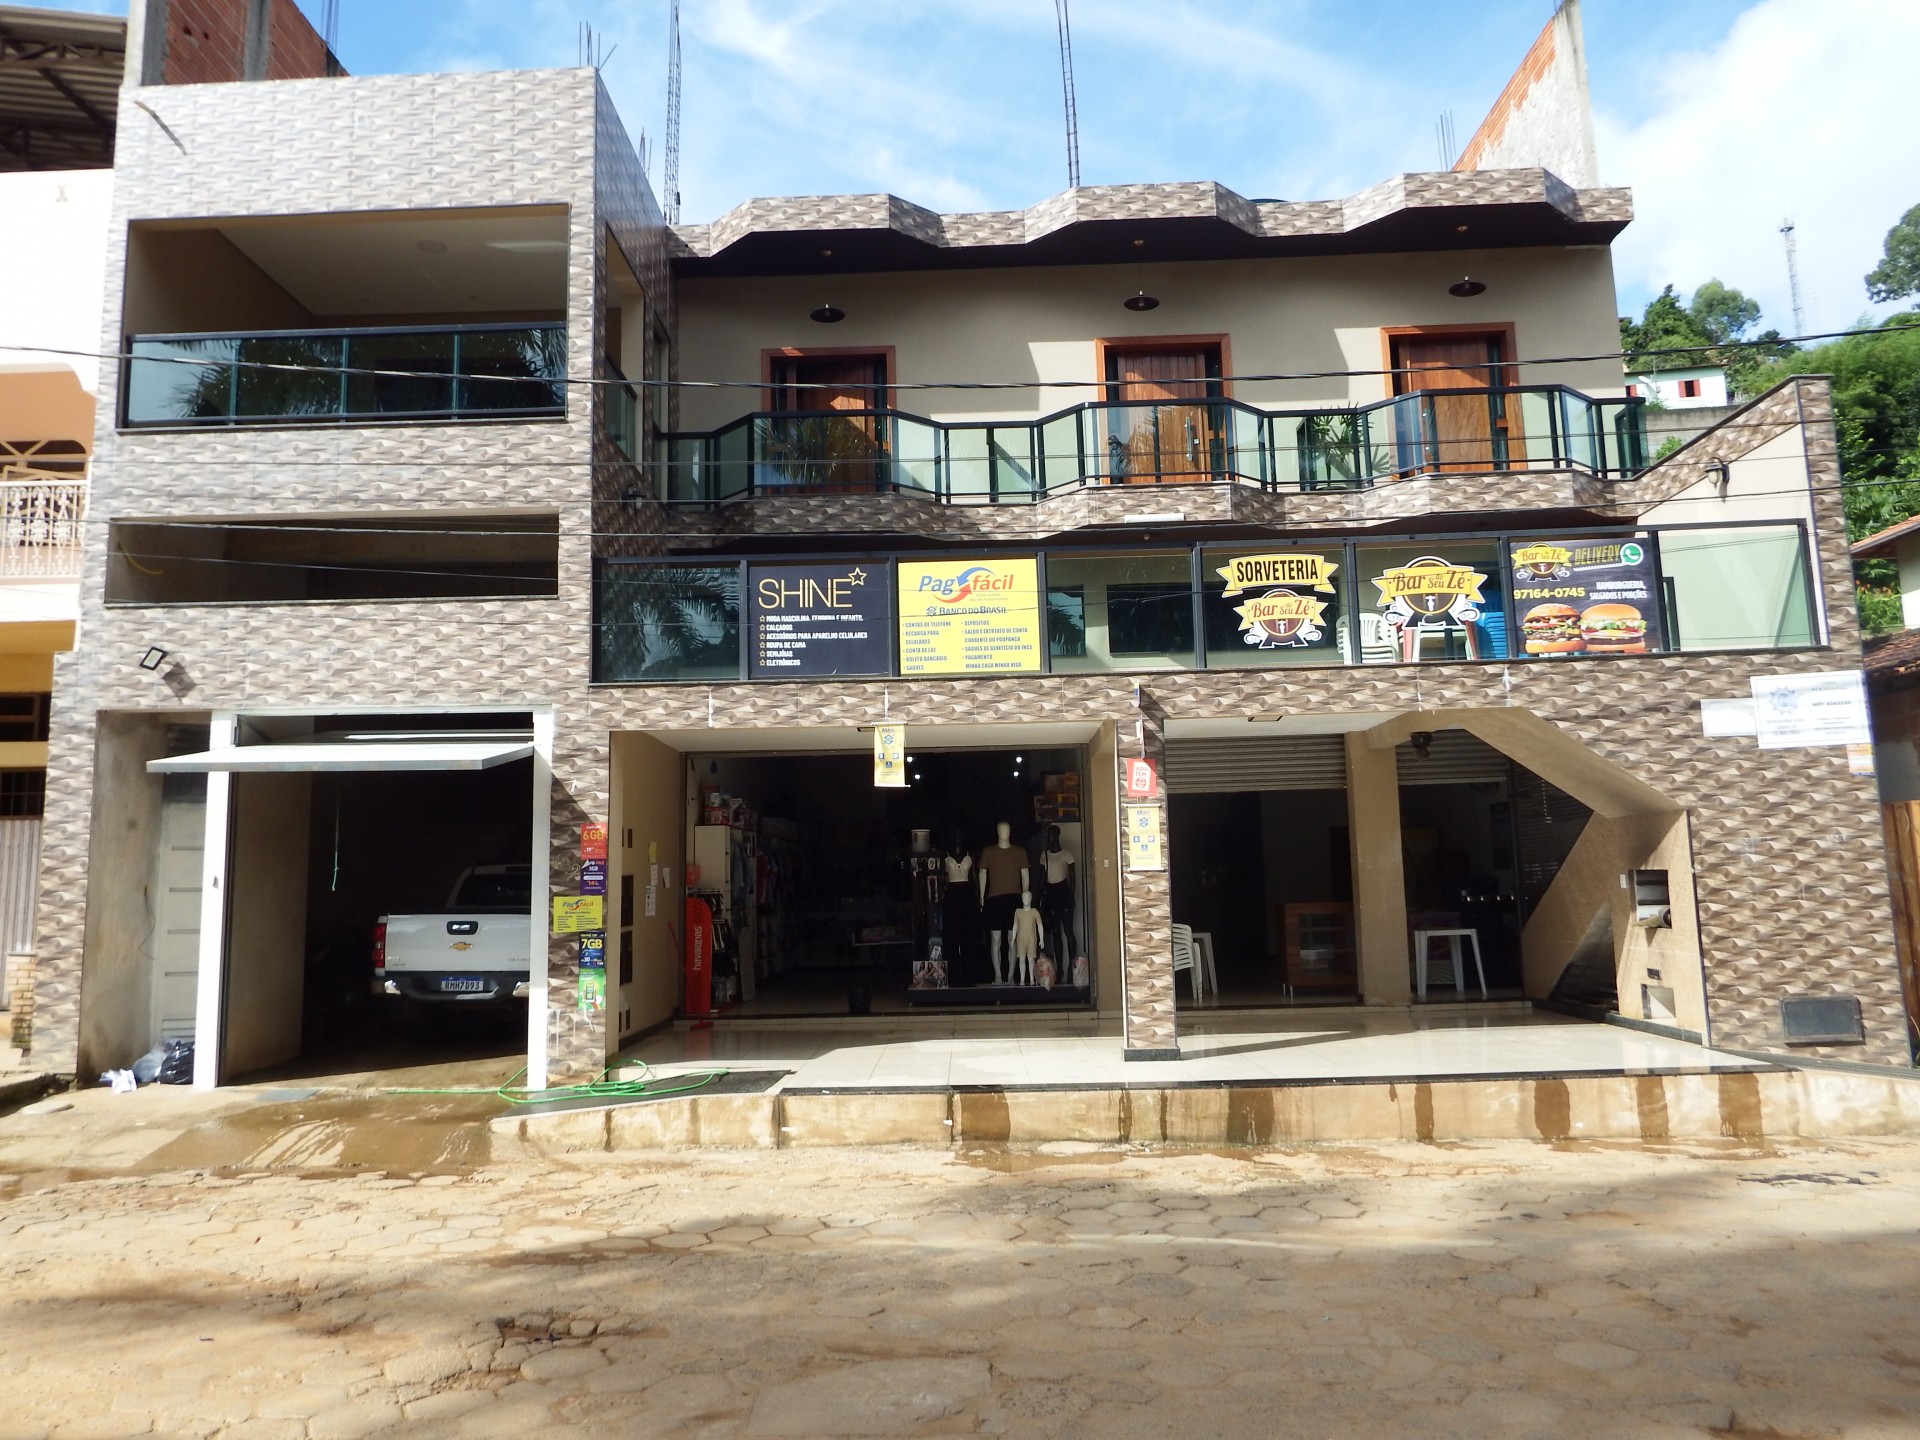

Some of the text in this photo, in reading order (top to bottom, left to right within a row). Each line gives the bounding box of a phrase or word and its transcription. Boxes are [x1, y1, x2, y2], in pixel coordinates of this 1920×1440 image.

[1521, 550, 1537, 561] Bar
[1237, 558, 1319, 583] SORVETERIA
[918, 574, 1014, 596] Pag fácil
[1393, 573, 1425, 592] Bar
[1428, 577, 1445, 589] Seu
[1446, 570, 1465, 589] Zé
[758, 578, 853, 609] SHINE
[1513, 586, 1586, 600] 97164-0745
[1251, 602, 1278, 619] Bar
[1279, 605, 1294, 615] Seu
[1294, 599, 1310, 615] Zé
[766, 624, 793, 632] CALÇADOS
[766, 632, 797, 640] ACESSÓRIOS
[838, 631, 868, 639] CELULARES
[766, 641, 783, 649] ROUPA
[766, 649, 793, 658] SEMIJÓIAS
[766, 658, 801, 667] ELETRÔNICOS
[581, 938, 603, 949] 7GB
